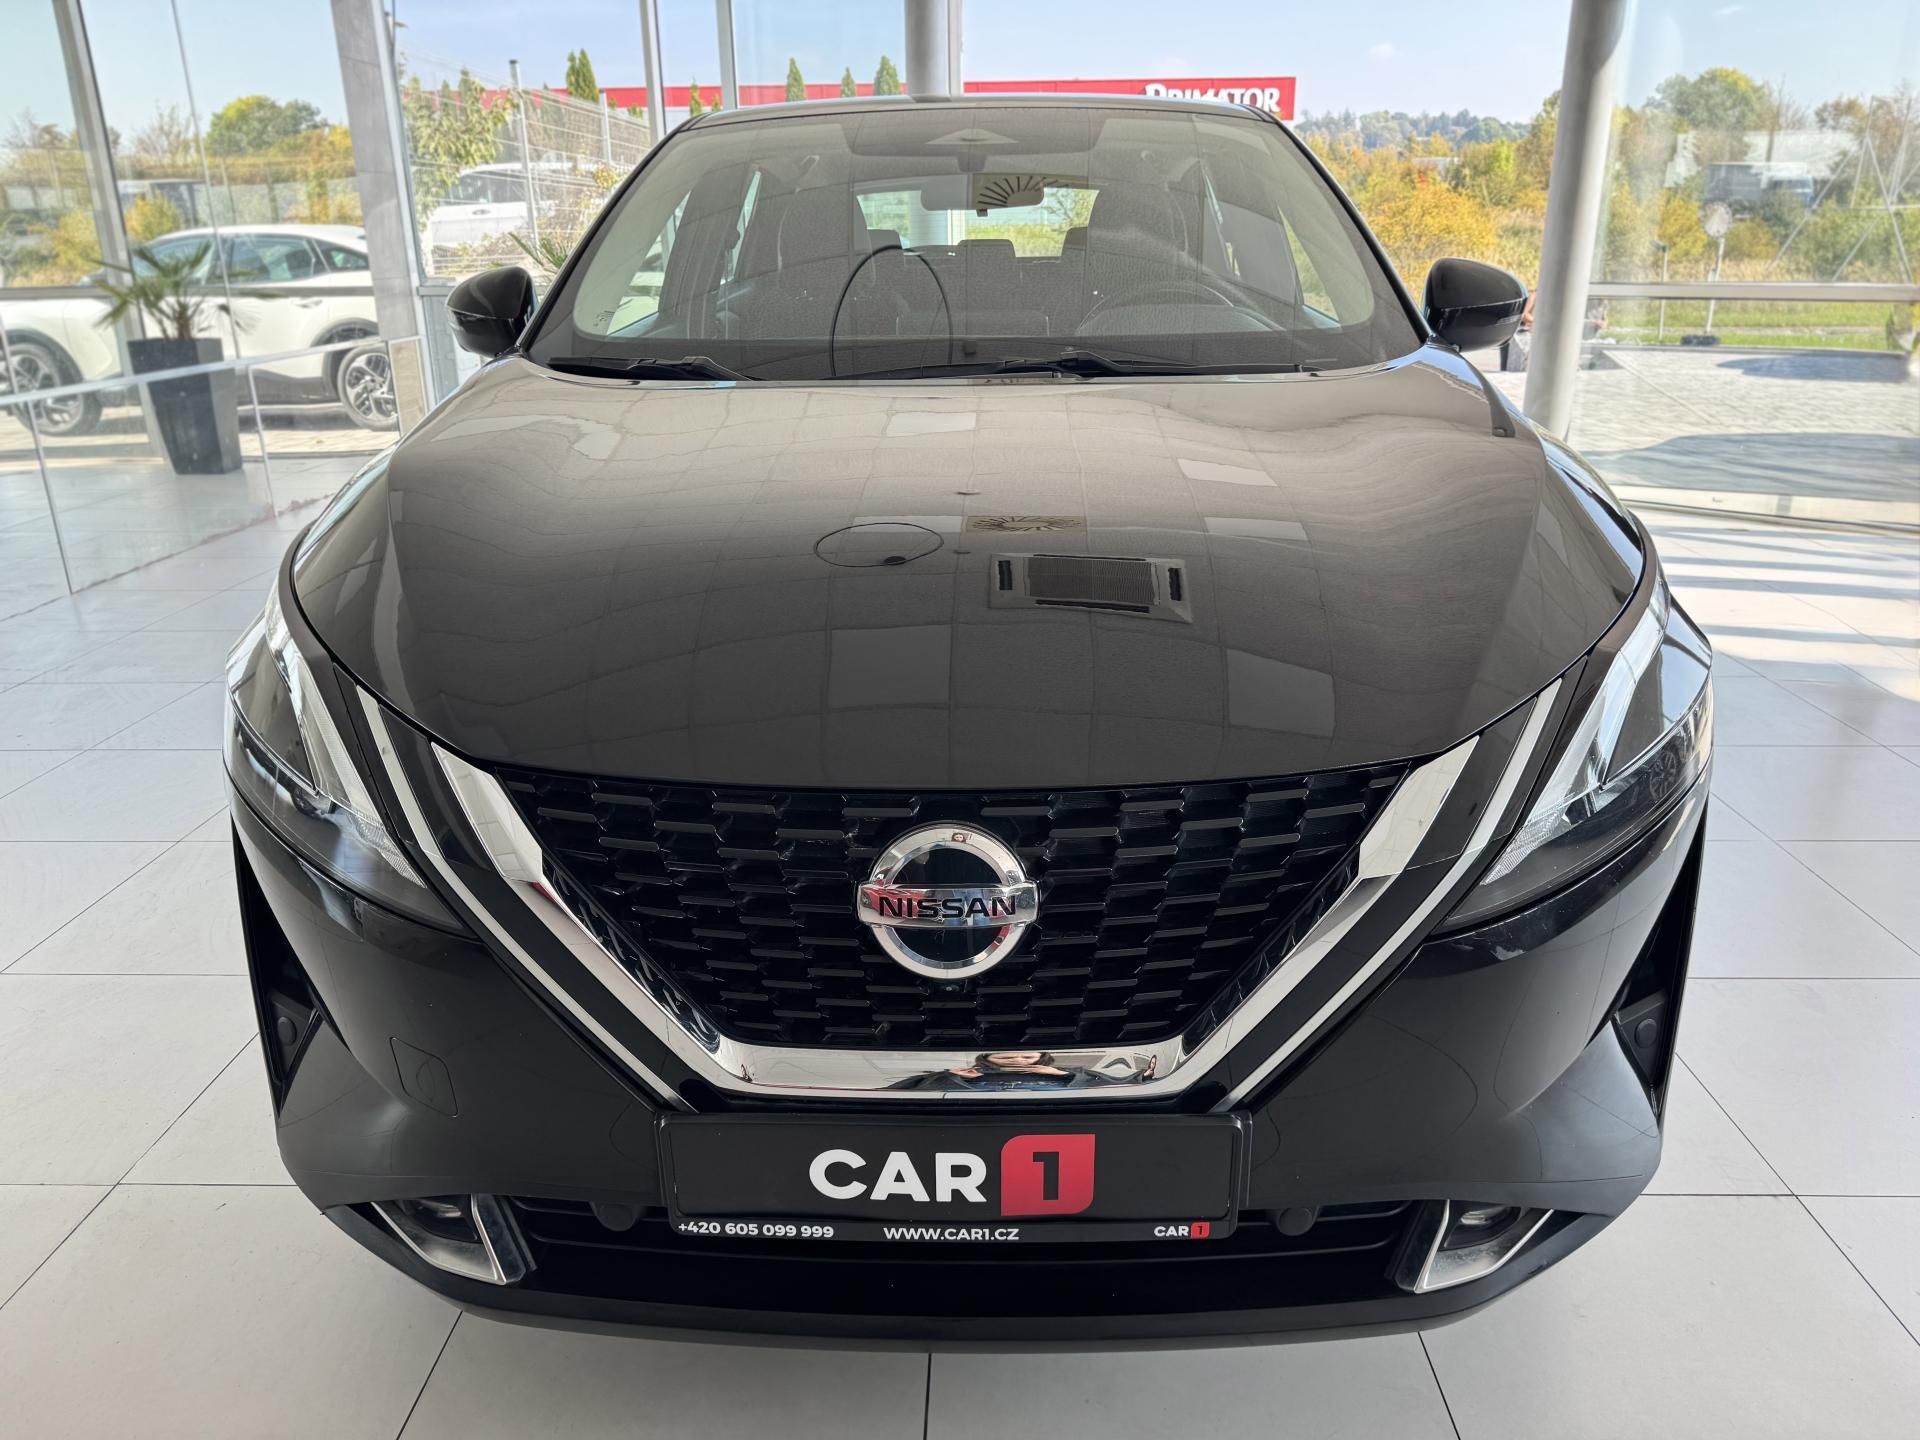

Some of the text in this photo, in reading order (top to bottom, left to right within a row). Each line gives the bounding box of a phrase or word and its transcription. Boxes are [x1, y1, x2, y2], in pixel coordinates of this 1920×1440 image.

[879, 895, 1017, 918] NISSAN
[809, 1149, 1060, 1202] CAR 1
[678, 1221, 834, 1238] +420 605 099 999
[883, 1227, 1020, 1241] WWW.CAR1.CZ
[1153, 1225, 1189, 1237] CAR
